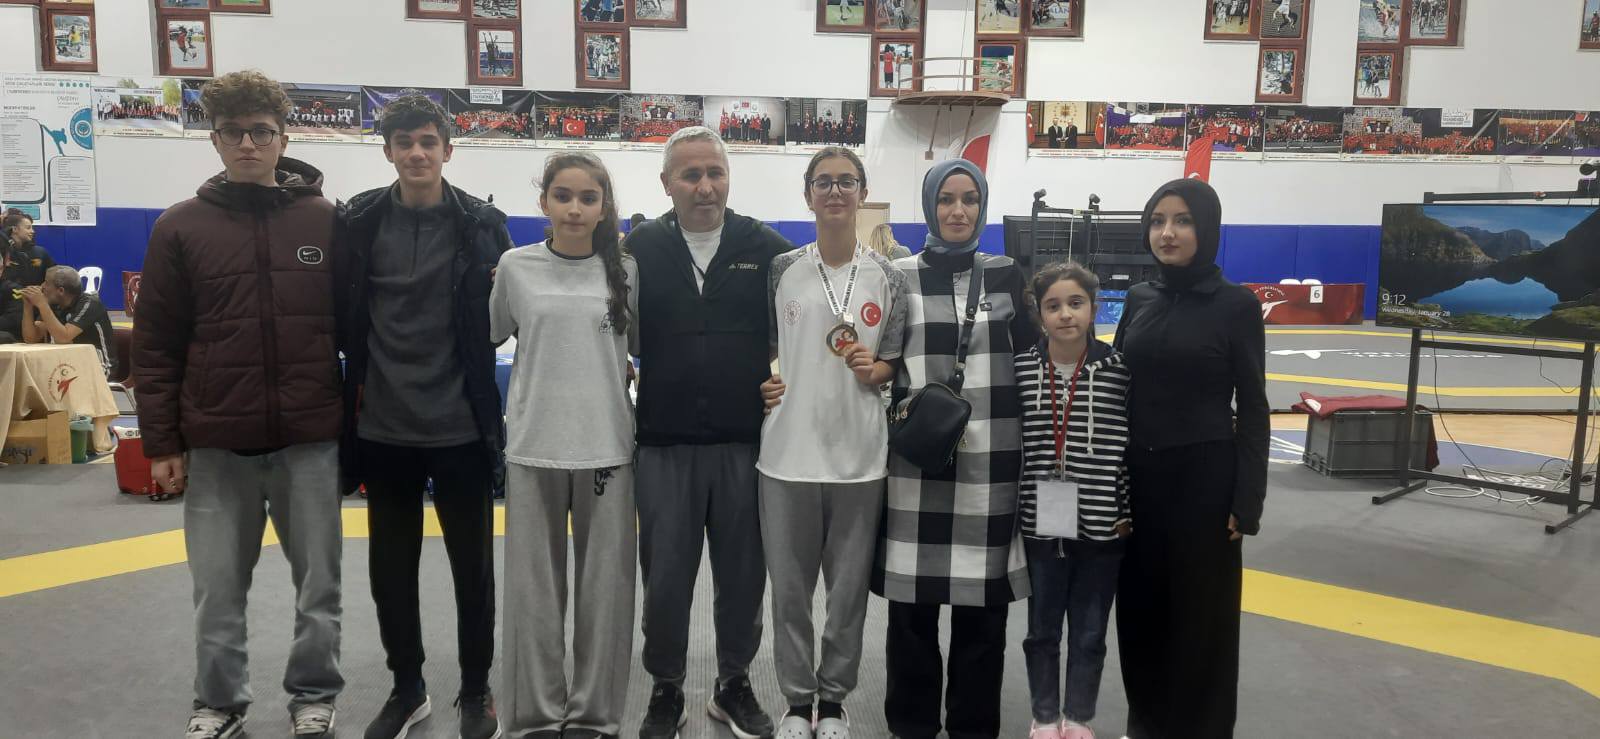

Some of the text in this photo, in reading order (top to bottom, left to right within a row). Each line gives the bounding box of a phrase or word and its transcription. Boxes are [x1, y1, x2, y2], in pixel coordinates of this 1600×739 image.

[1313, 289, 1321, 299] 6
[1382, 293, 1406, 306] 9:12
[1418, 309, 1442, 318] January
